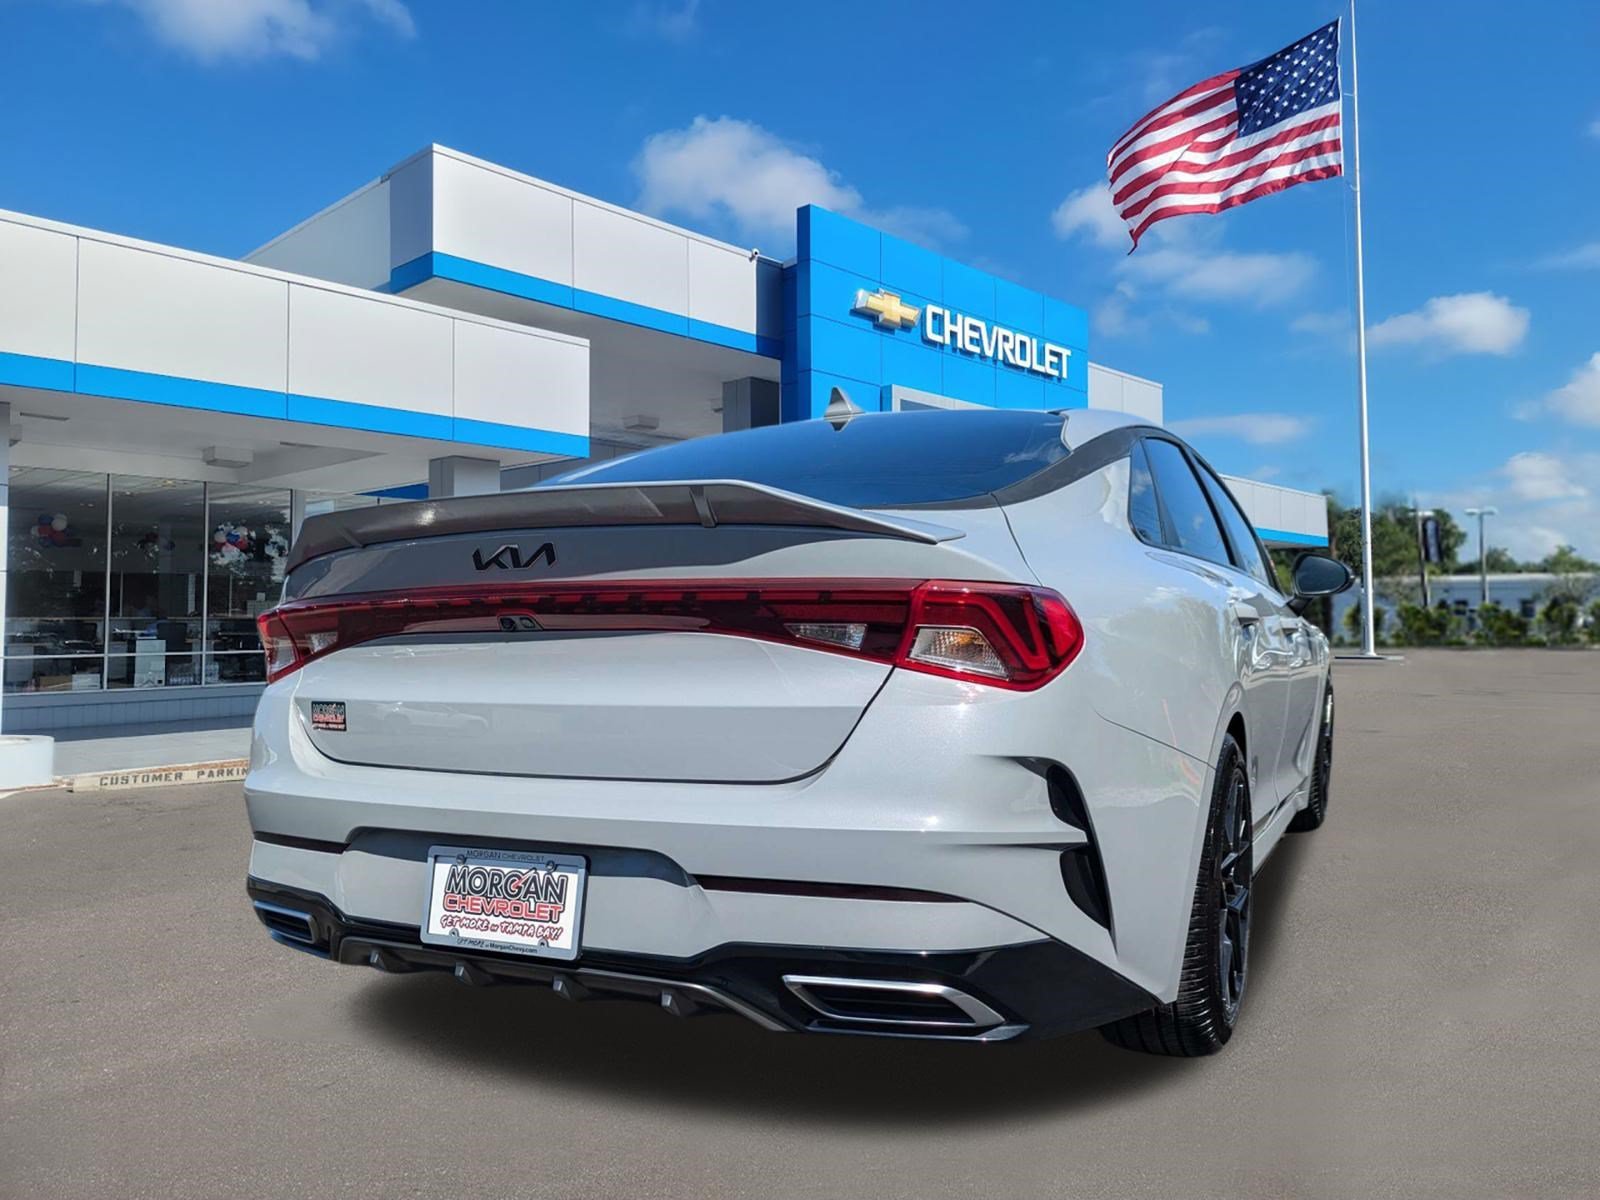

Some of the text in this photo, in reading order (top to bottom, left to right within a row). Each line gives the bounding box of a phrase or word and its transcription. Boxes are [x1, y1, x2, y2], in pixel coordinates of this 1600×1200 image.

[923, 303, 1072, 380] CHEVROLET
[472, 542, 556, 571] KIA
[100, 767, 249, 786] CUSTOMER PARKIN
[466, 849, 545, 862] MORGAN CHEVROLET
[445, 865, 568, 905] MORGAN
[443, 893, 564, 922] CHEVROLET
[440, 914, 460, 929] GET
[459, 917, 489, 931] MORE
[499, 920, 535, 937] TAMPA
[535, 924, 564, 941] BAY!
